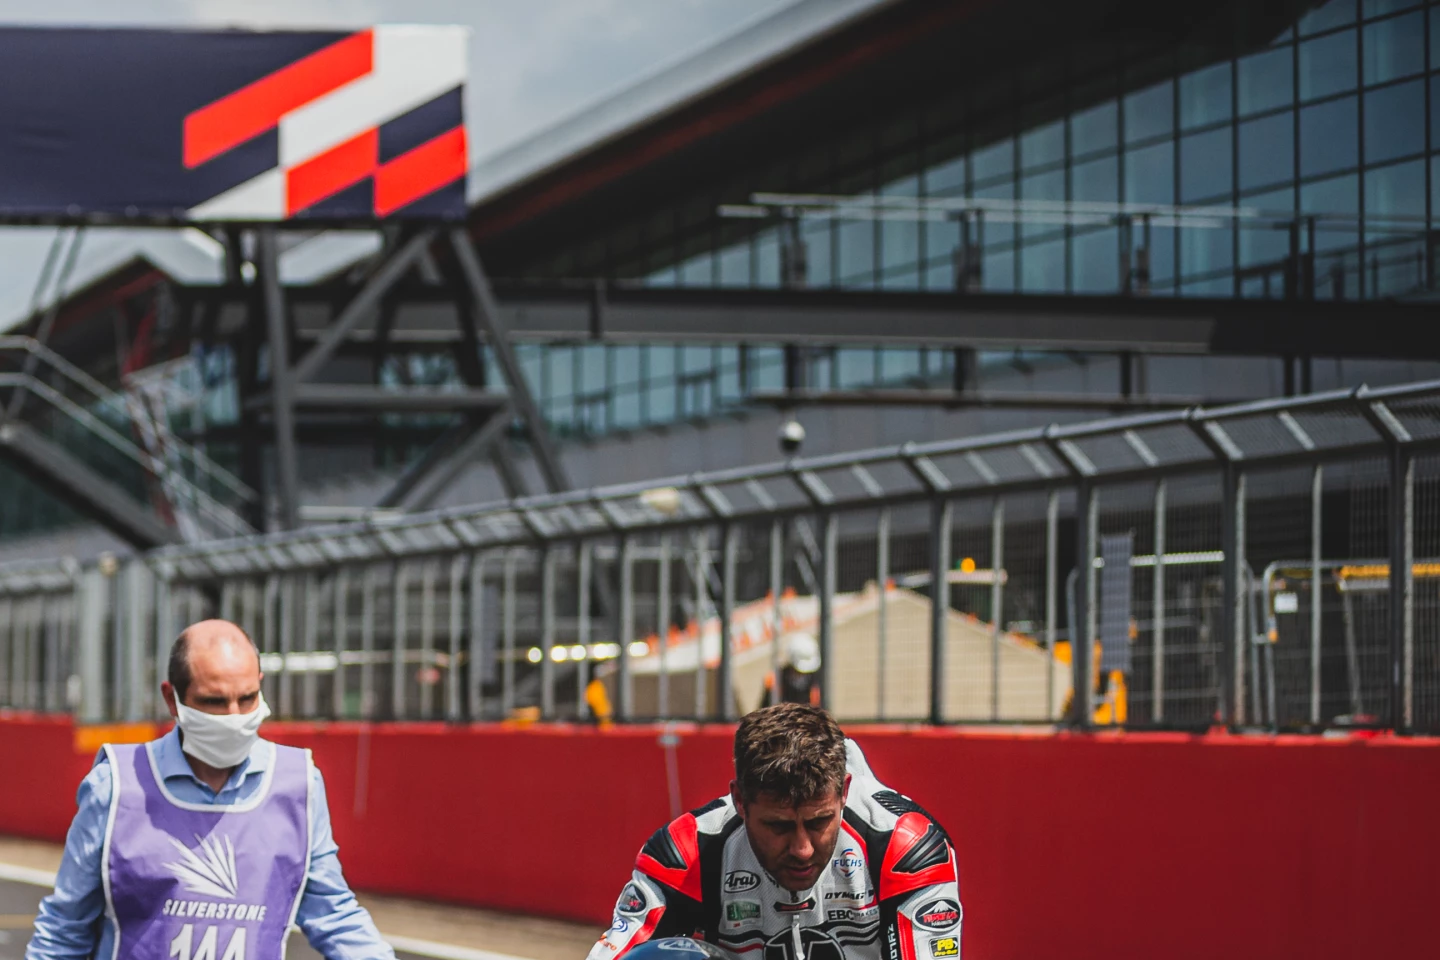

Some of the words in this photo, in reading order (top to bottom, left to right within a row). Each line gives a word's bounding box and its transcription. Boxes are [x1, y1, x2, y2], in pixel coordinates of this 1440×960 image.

[833, 859, 863, 868] FUCHS
[724, 872, 756, 888] Arai
[825, 891, 866, 900] DYMAG
[162, 899, 267, 922] SILVERSTONE
[827, 909, 854, 921] EBC
[936, 938, 955, 952] PB
